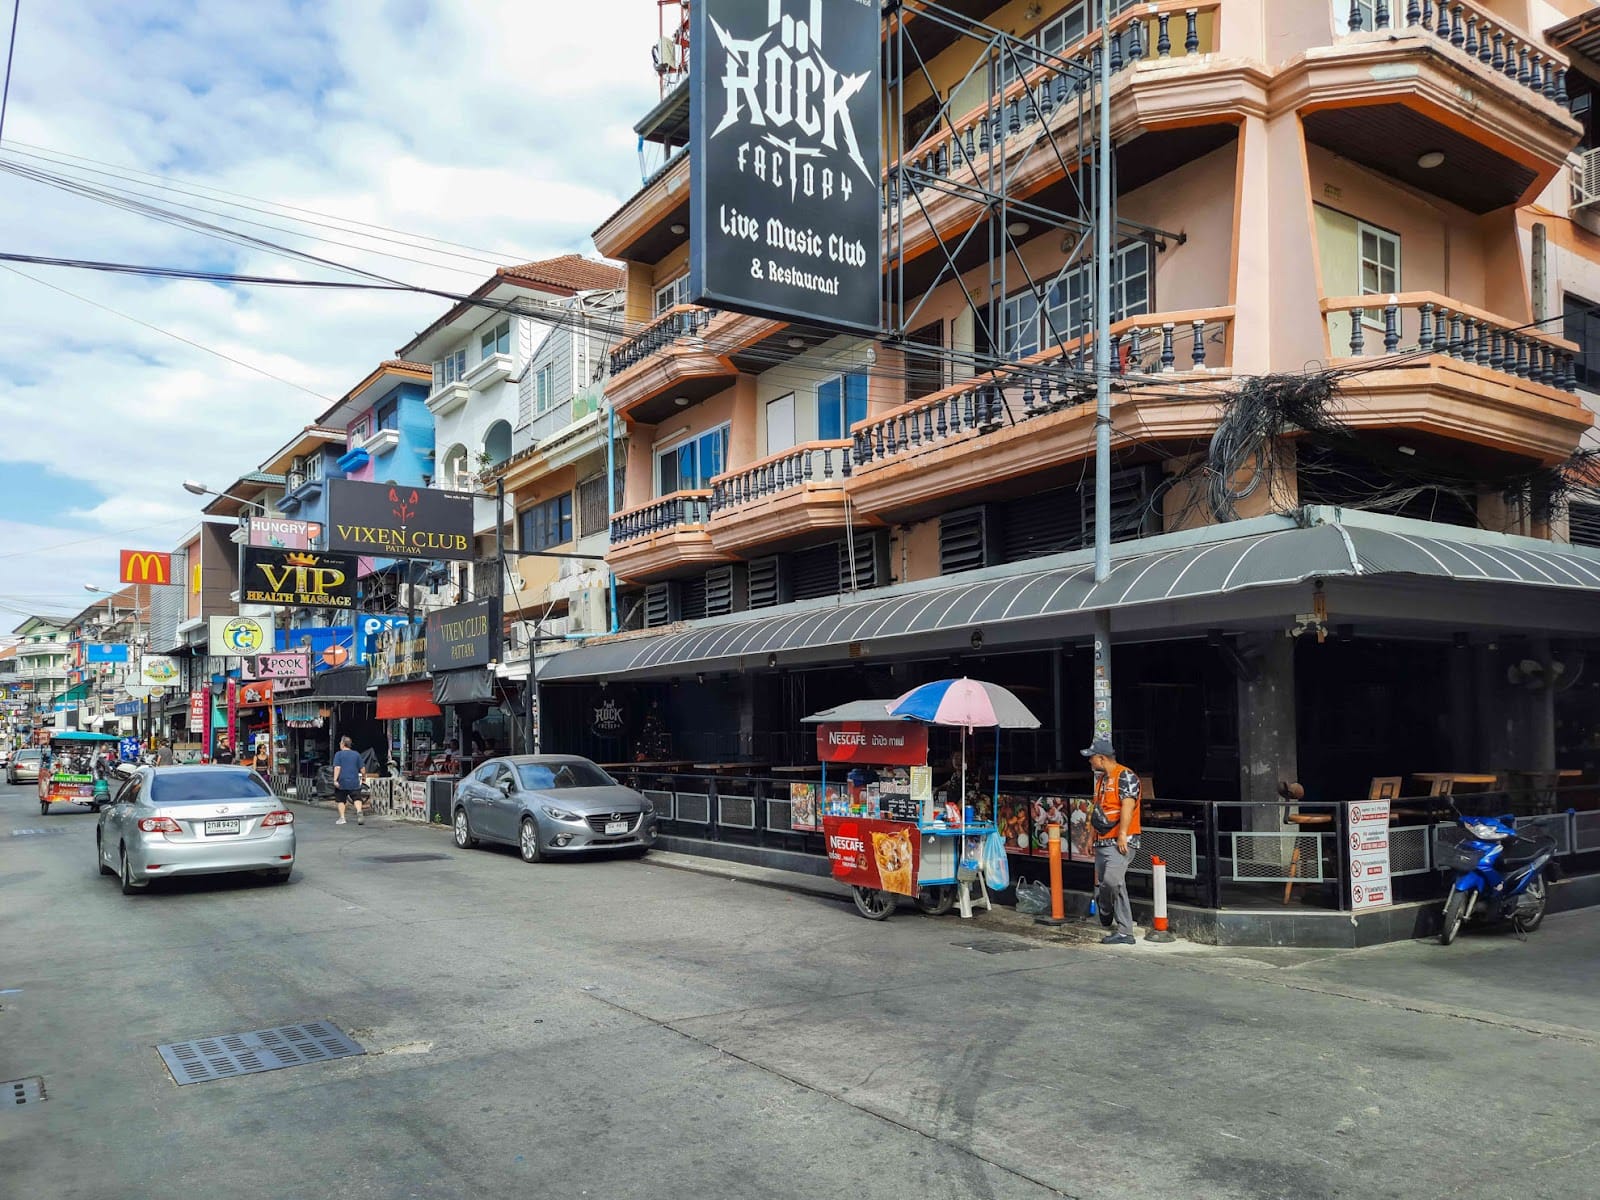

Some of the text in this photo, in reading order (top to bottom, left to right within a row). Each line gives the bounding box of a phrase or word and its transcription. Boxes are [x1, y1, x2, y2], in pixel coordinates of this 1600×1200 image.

[708, 13, 876, 188] ROCK
[738, 133, 852, 204] FACTORY
[720, 204, 866, 267] Live Music Club
[751, 258, 839, 296] & Restaurant
[250, 520, 307, 535] HUNGRY
[337, 525, 468, 550] VIXEN CLUB
[386, 545, 421, 554] PATTAYA
[256, 563, 345, 596] VIP
[246, 591, 352, 606] HEALTH MASSAGE
[440, 615, 488, 641] VIXEN CLUB
[451, 643, 475, 659] PATTAYA
[271, 659, 303, 669] POOK
[593, 706, 624, 724] ROCK
